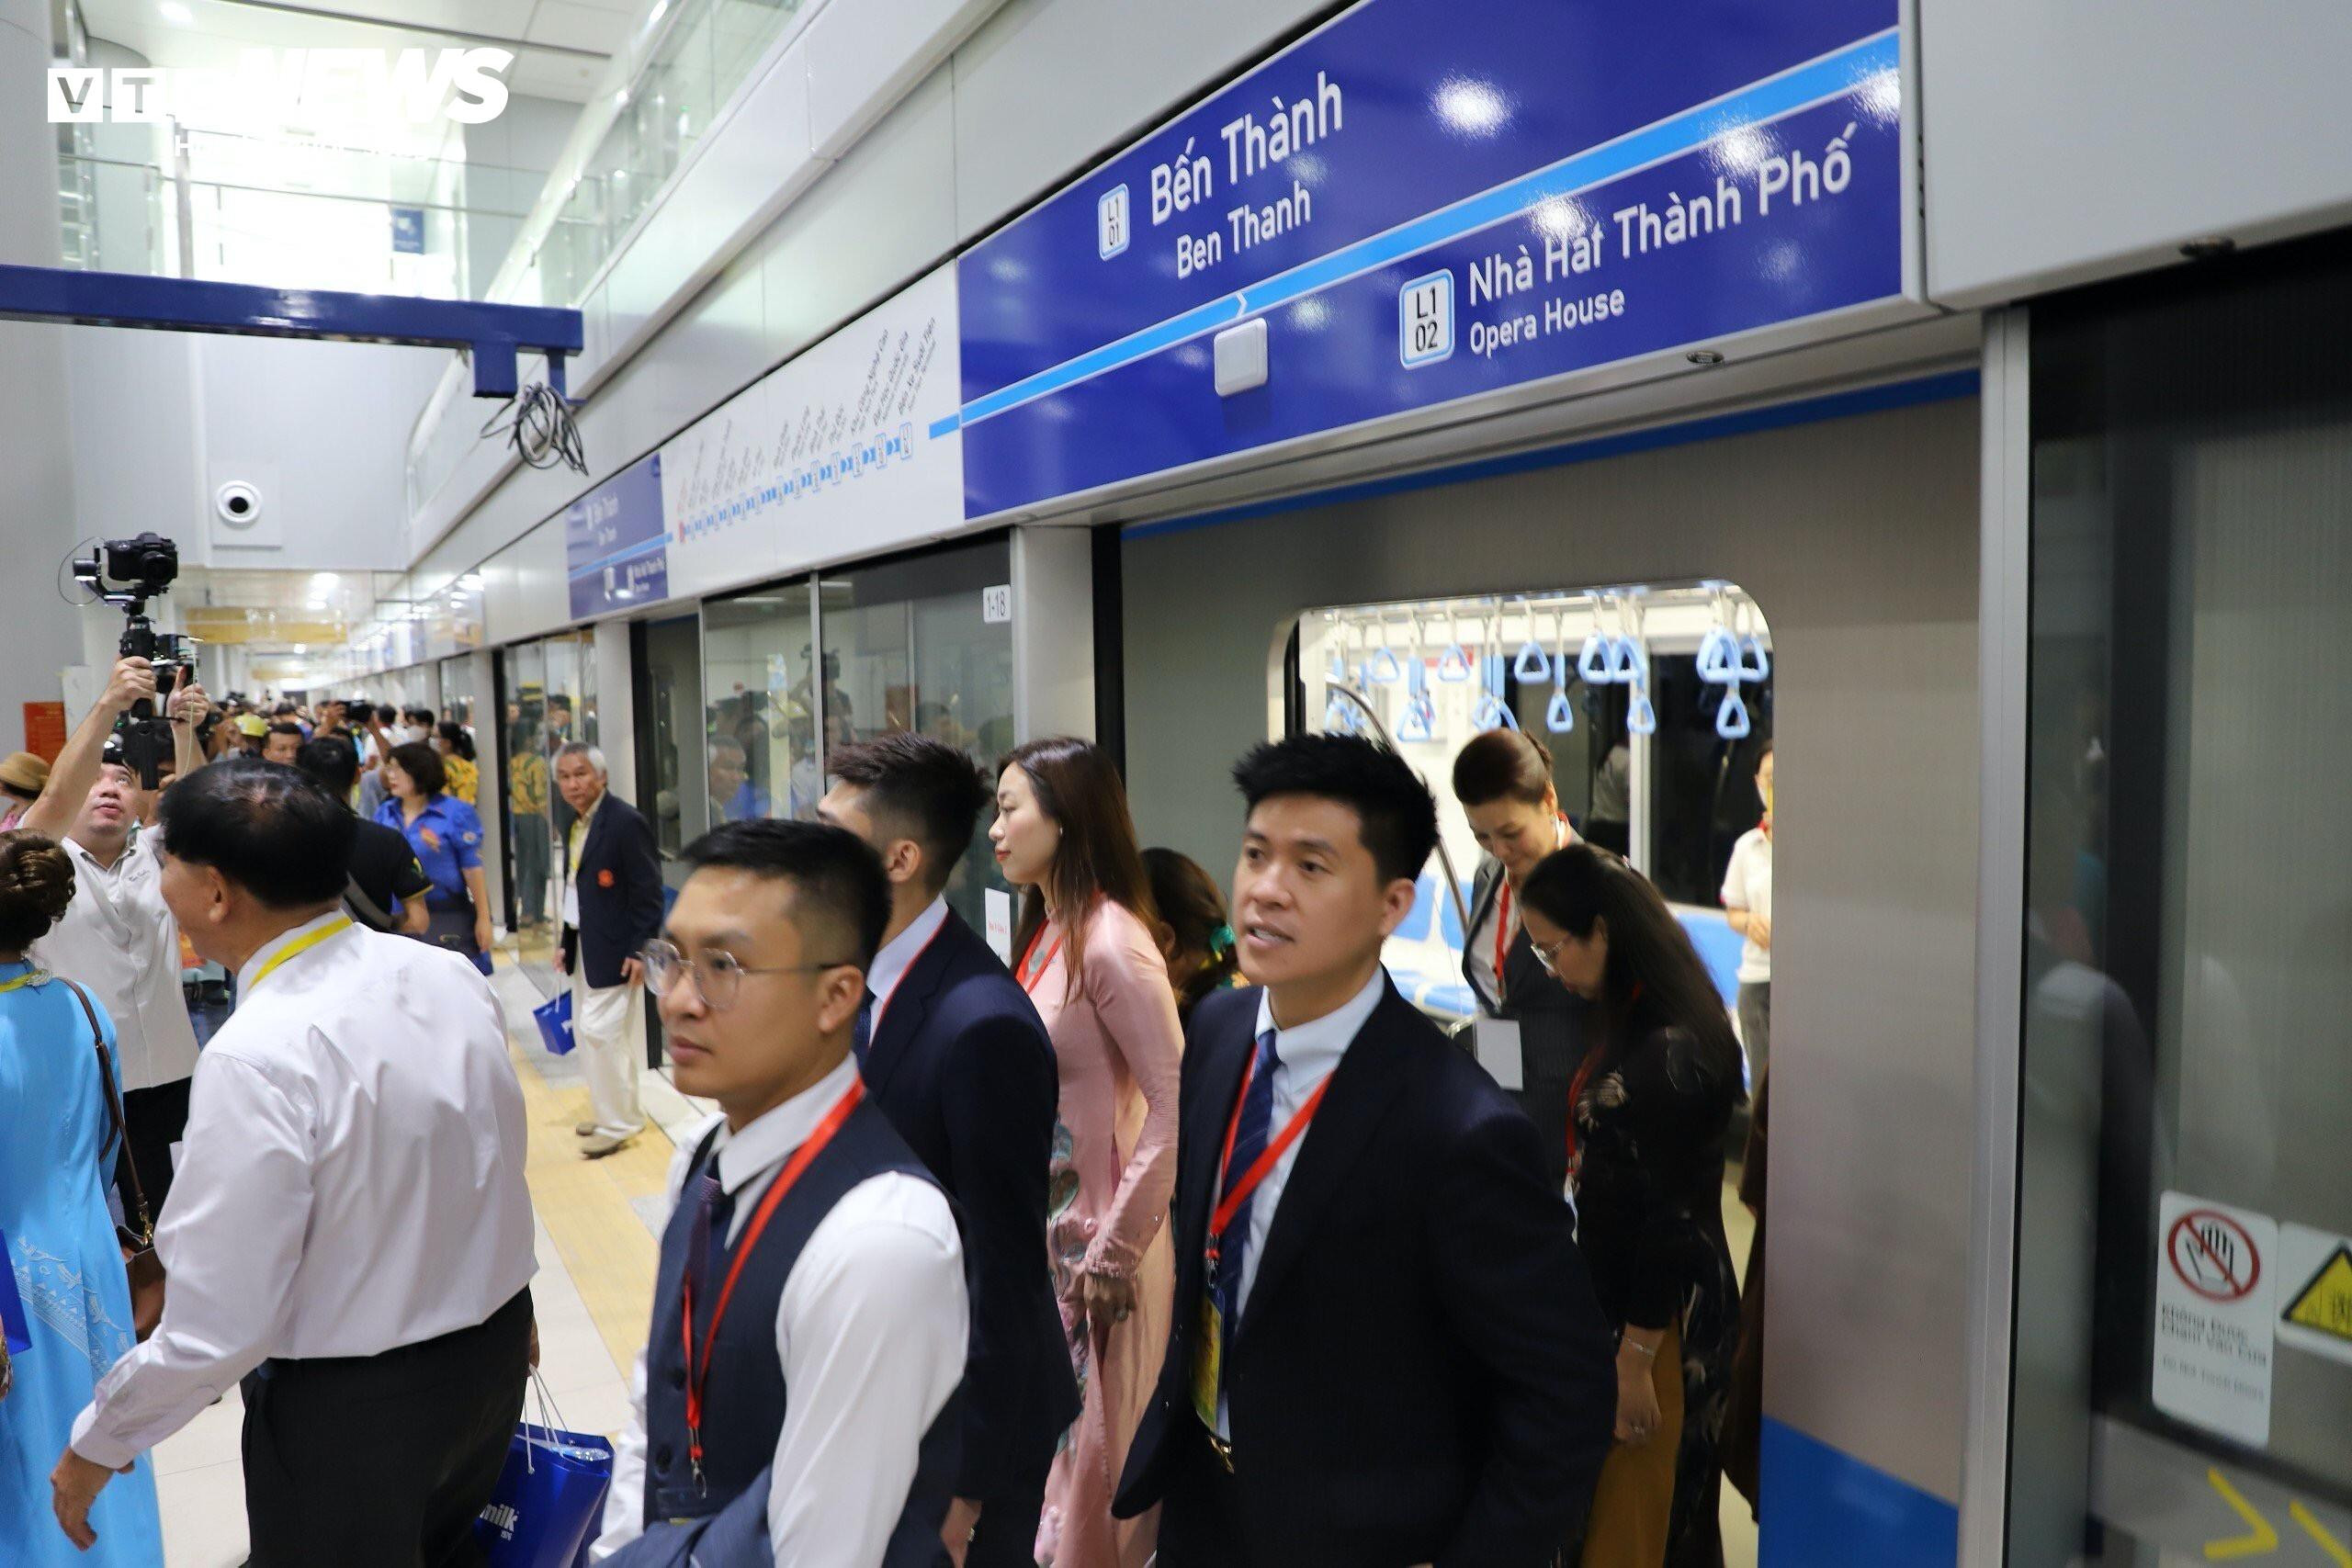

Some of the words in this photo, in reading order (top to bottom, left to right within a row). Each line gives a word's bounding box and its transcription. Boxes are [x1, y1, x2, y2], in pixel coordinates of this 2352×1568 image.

[1151, 137, 1212, 226] Bến
[1221, 71, 1343, 184] Thành
[1177, 231, 1221, 279] Ben
[1228, 181, 1311, 254] Thanh
[1469, 244, 1532, 308] Nhà
[1613, 179, 1743, 259] Thành
[1758, 120, 1858, 216] Phố
[1415, 286, 1438, 319] L1
[1415, 320, 1439, 353] 02
[1469, 311, 1537, 359] Opera
[1544, 288, 1625, 335] House
